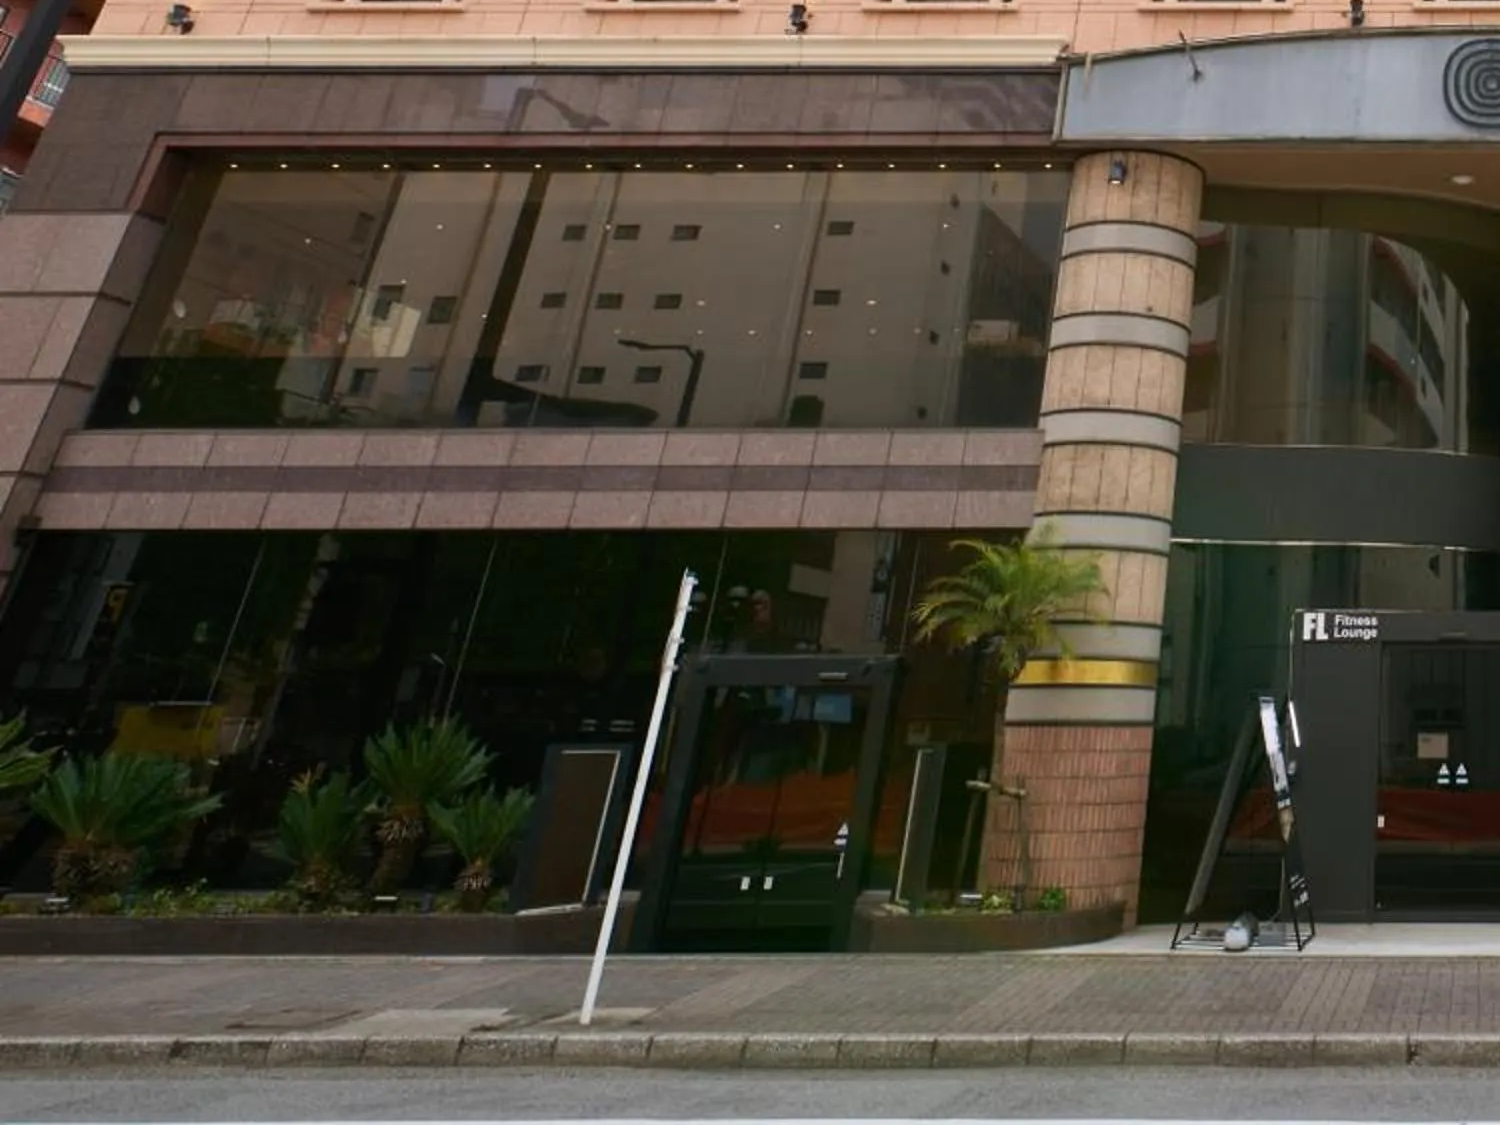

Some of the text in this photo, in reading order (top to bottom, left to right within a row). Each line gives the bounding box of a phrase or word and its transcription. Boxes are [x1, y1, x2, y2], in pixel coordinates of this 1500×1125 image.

[1303, 612, 1329, 641] FL
[1335, 615, 1378, 626] Fitness
[1334, 627, 1378, 640] Lounge
